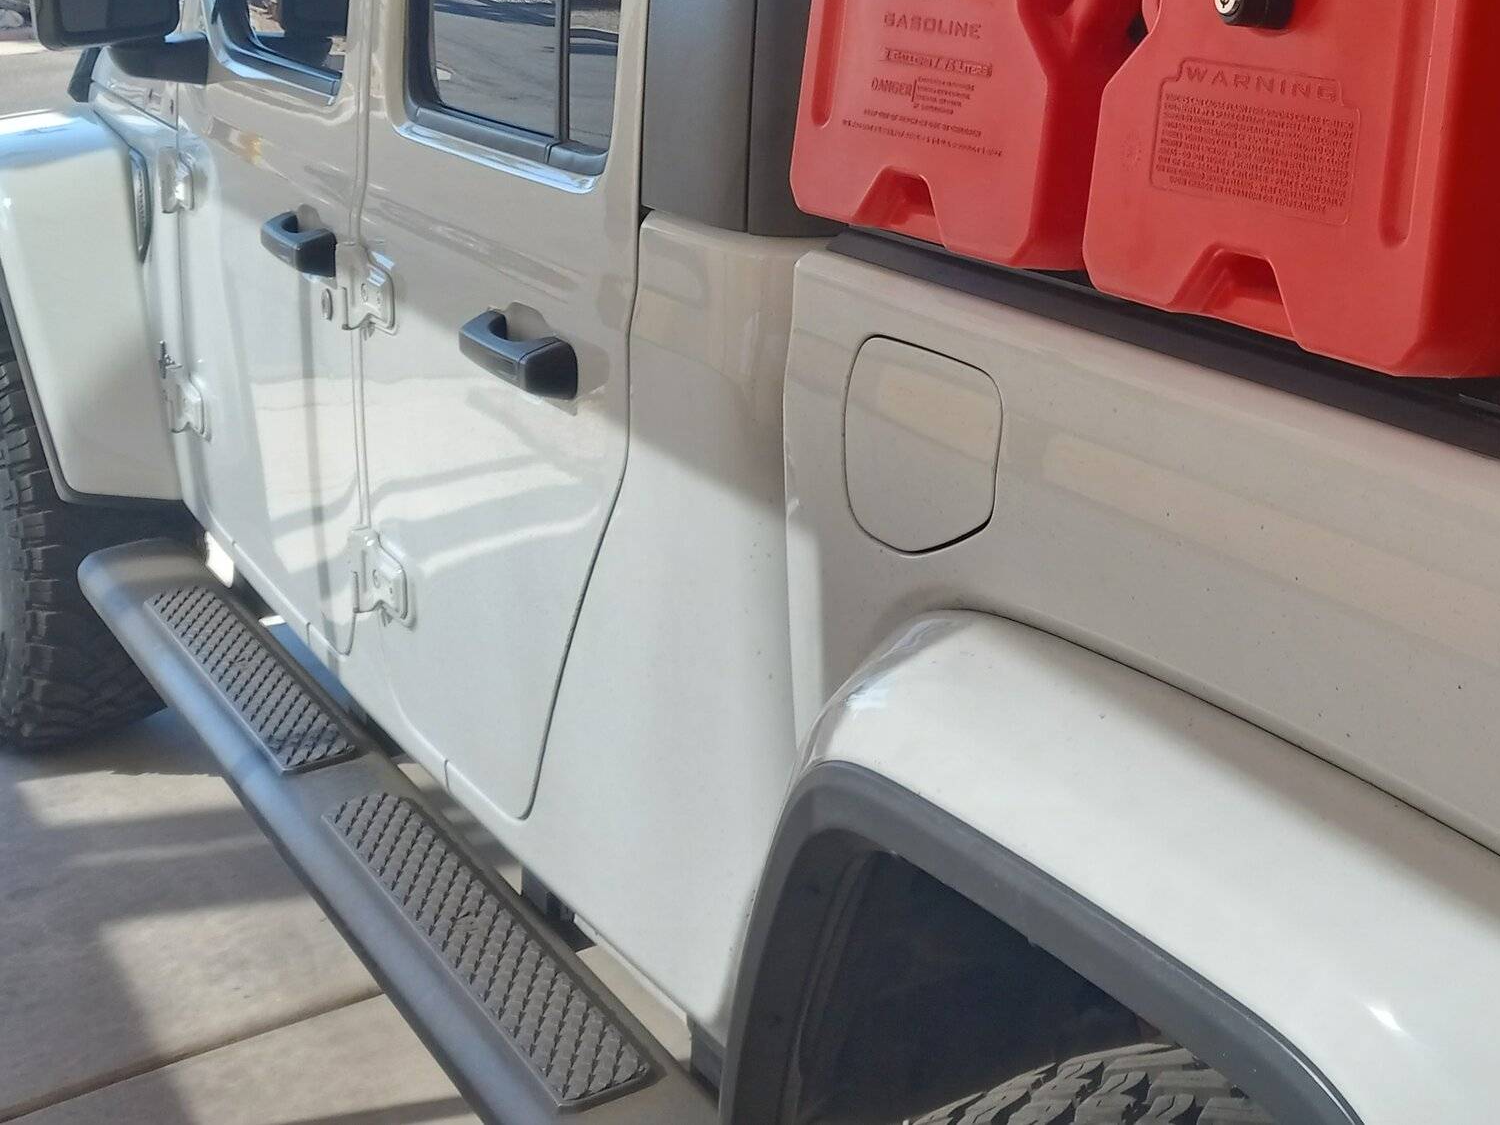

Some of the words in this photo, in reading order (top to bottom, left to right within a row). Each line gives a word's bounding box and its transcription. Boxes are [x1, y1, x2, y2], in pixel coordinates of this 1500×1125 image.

[884, 12, 982, 40] GASOLINE
[870, 76, 913, 98] DANGER
[1184, 64, 1339, 103] WARNING
